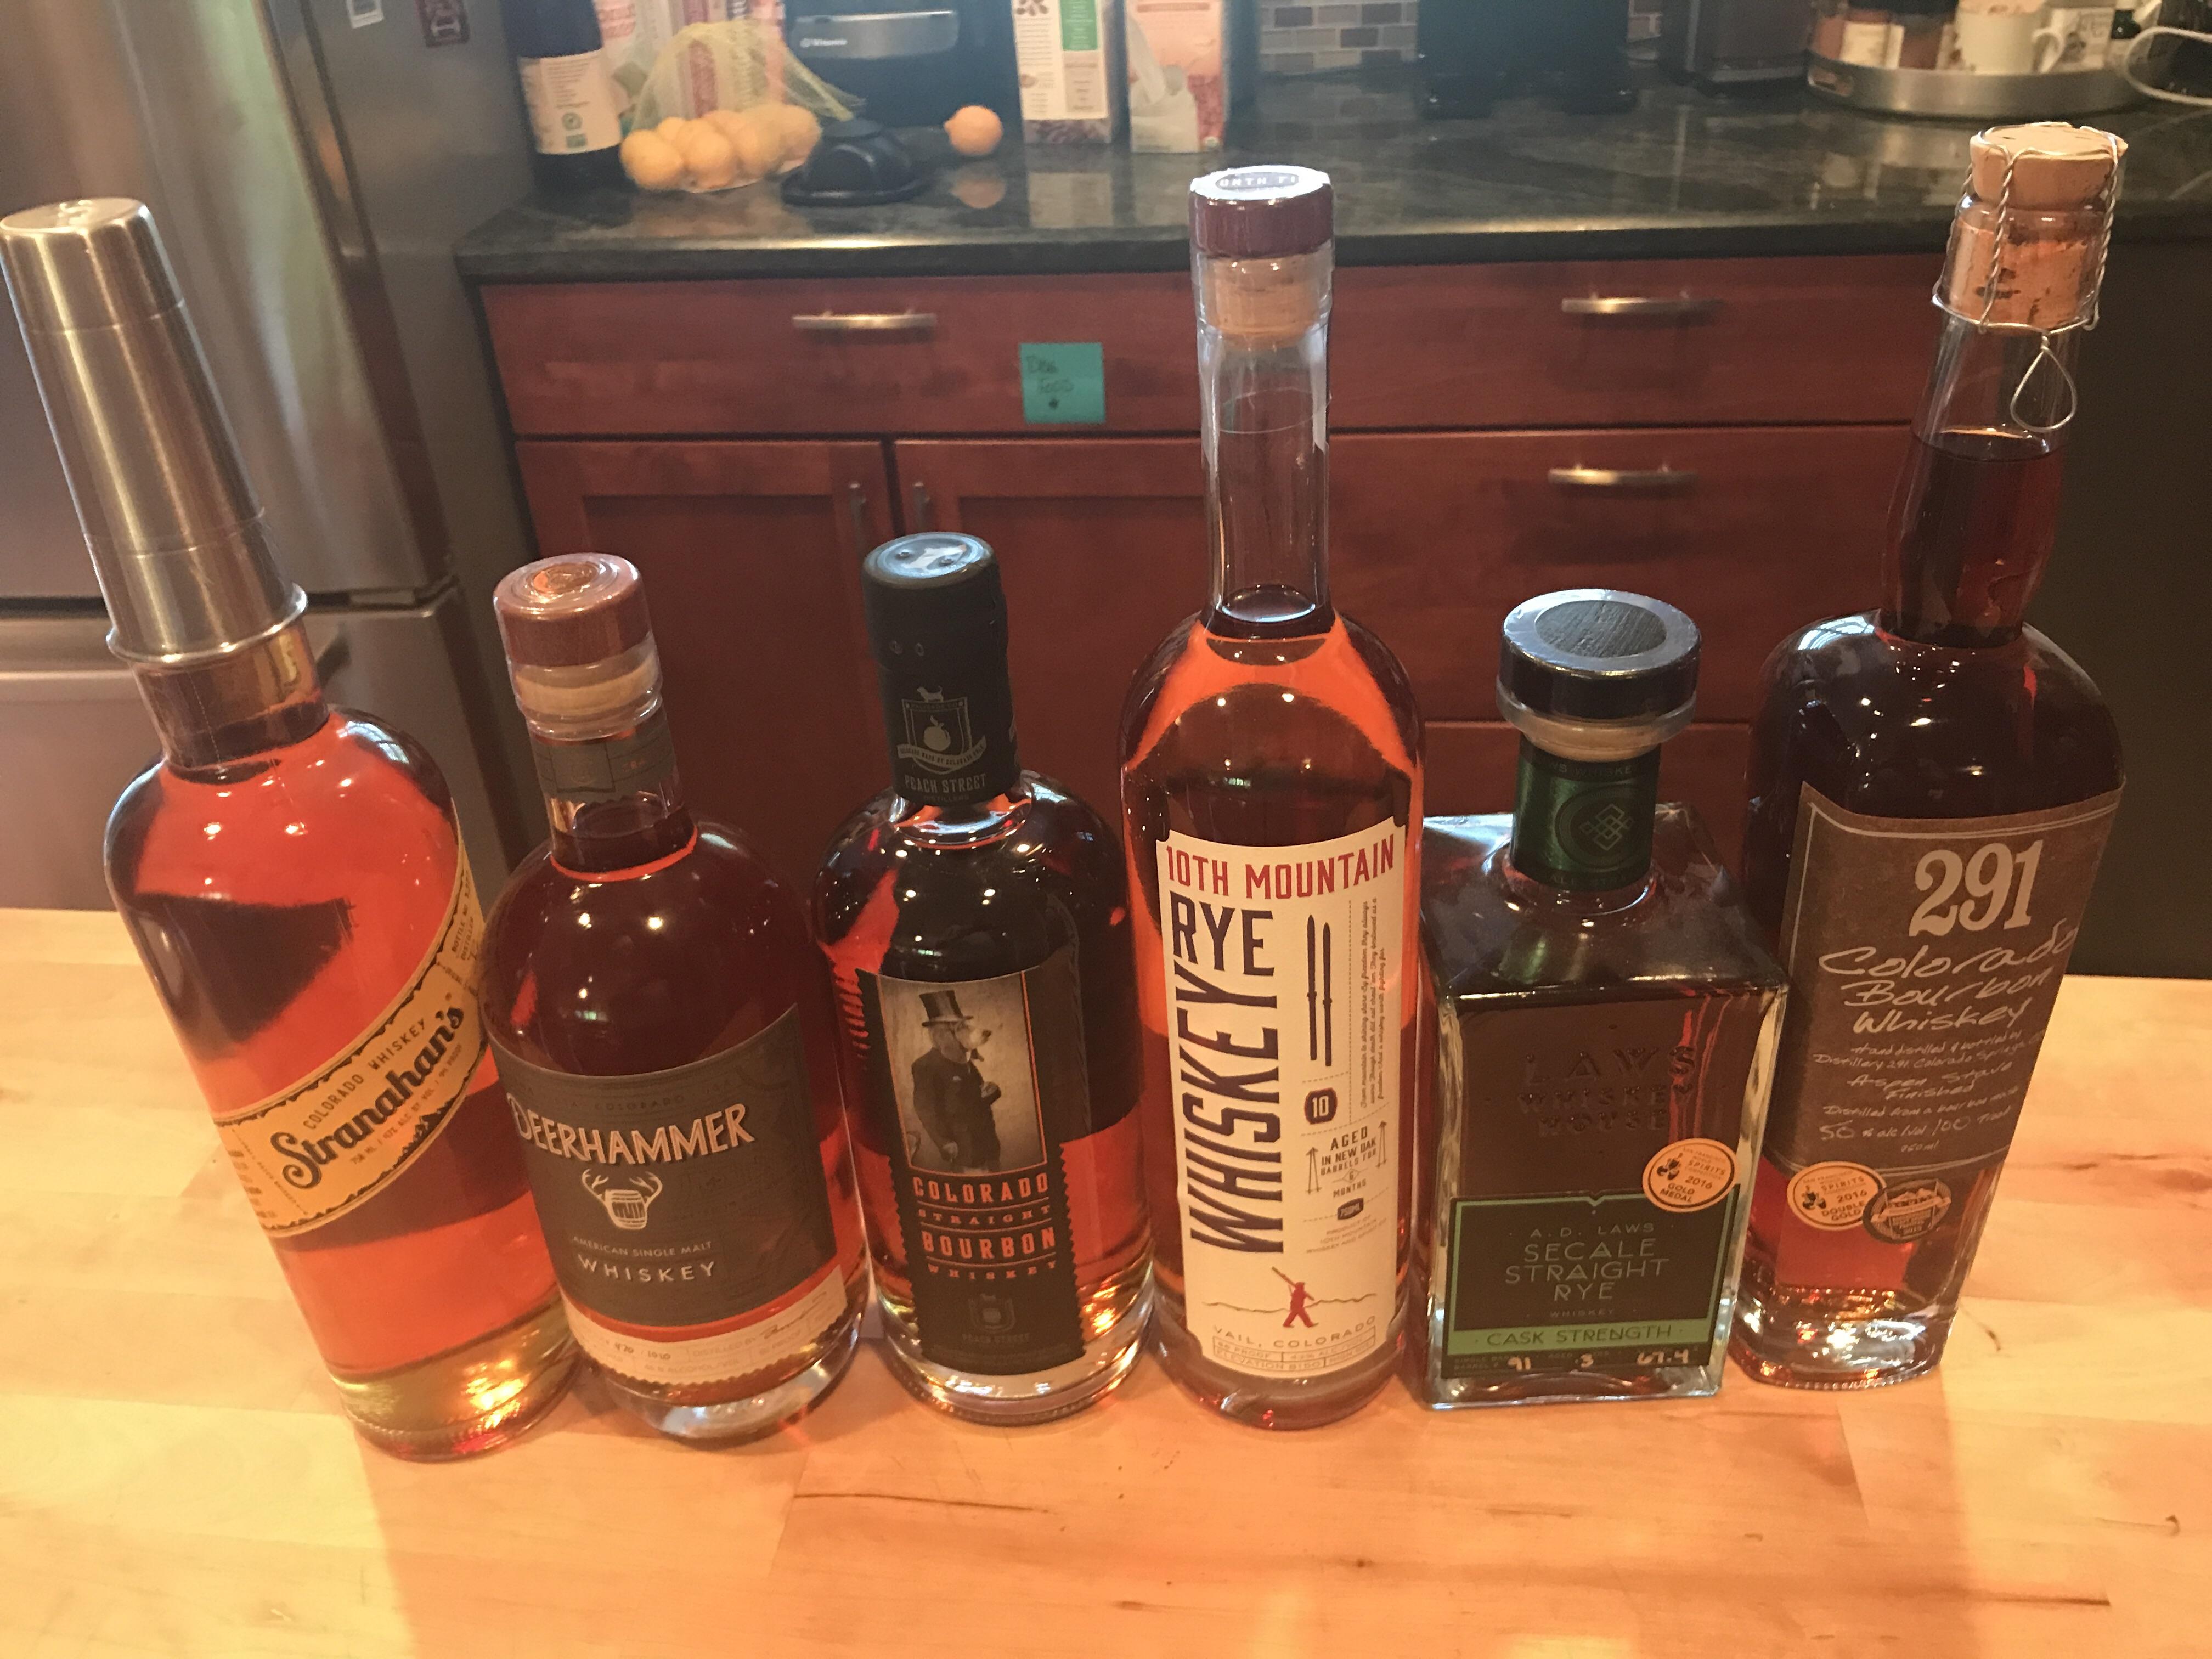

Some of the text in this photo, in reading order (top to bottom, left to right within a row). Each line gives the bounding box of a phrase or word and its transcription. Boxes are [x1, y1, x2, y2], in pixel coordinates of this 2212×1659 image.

[904, 772, 986, 793] PEACH STREET
[1166, 833, 1395, 900] 10TH MOUNTAIN
[1909, 839, 2045, 938] 291
[1169, 890, 1275, 977] RYE
[1818, 917, 2079, 979] Colorado
[1842, 966, 2055, 1007] Bourbon
[1853, 997, 2034, 1035] Whiskey
[368, 1017, 427, 1070] WHISKEY
[1524, 1045, 1696, 1085] LAWS
[1846, 1061, 2013, 1092] Aspen Stave
[270, 1003, 465, 1189] Stranahan's
[303, 1074, 364, 1130] COLORADO
[1174, 959, 1284, 1254] WHISKEY
[1312, 1094, 1329, 1118] 10
[506, 1092, 755, 1165] DEERHAMMER
[1330, 1125, 1368, 1152] AGED
[1819, 1120, 1855, 1141] 50
[1322, 1136, 1377, 1166] IN NEW OAK
[1321, 1157, 1359, 1176] BARRELS
[1688, 1159, 1727, 1176] SPIRITS
[913, 1172, 1048, 1203] COLORADO
[1333, 1178, 1367, 1198] MONTHS
[1668, 1183, 1696, 1195] GOLD
[1685, 1175, 1713, 1189] 2016
[1821, 1175, 1865, 1192] SPIRITS
[1659, 1188, 1692, 1203] MEDAL
[1836, 1189, 1867, 1204] 2016
[918, 1204, 1051, 1225] STRAIGHT
[1821, 1200, 1866, 1217] DOUBLE
[1831, 1209, 1861, 1221] GOLD
[1597, 1222, 1655, 1237] LAWS
[572, 1235, 713, 1258] AMERICAN SINGLE MALT
[921, 1226, 1056, 1260] BOURBON
[1523, 1239, 1657, 1262] SECALE
[577, 1253, 715, 1283] WHISKEY
[927, 1260, 1056, 1280] WHISKEY
[1505, 1257, 1670, 1285] STRAIGHT
[1553, 1282, 1615, 1302] RYE
[1549, 1308, 1616, 1318] WHISKEY
[1273, 1315, 1376, 1348] COLORADO
[1486, 1324, 1673, 1348] CASK STRENGTH
